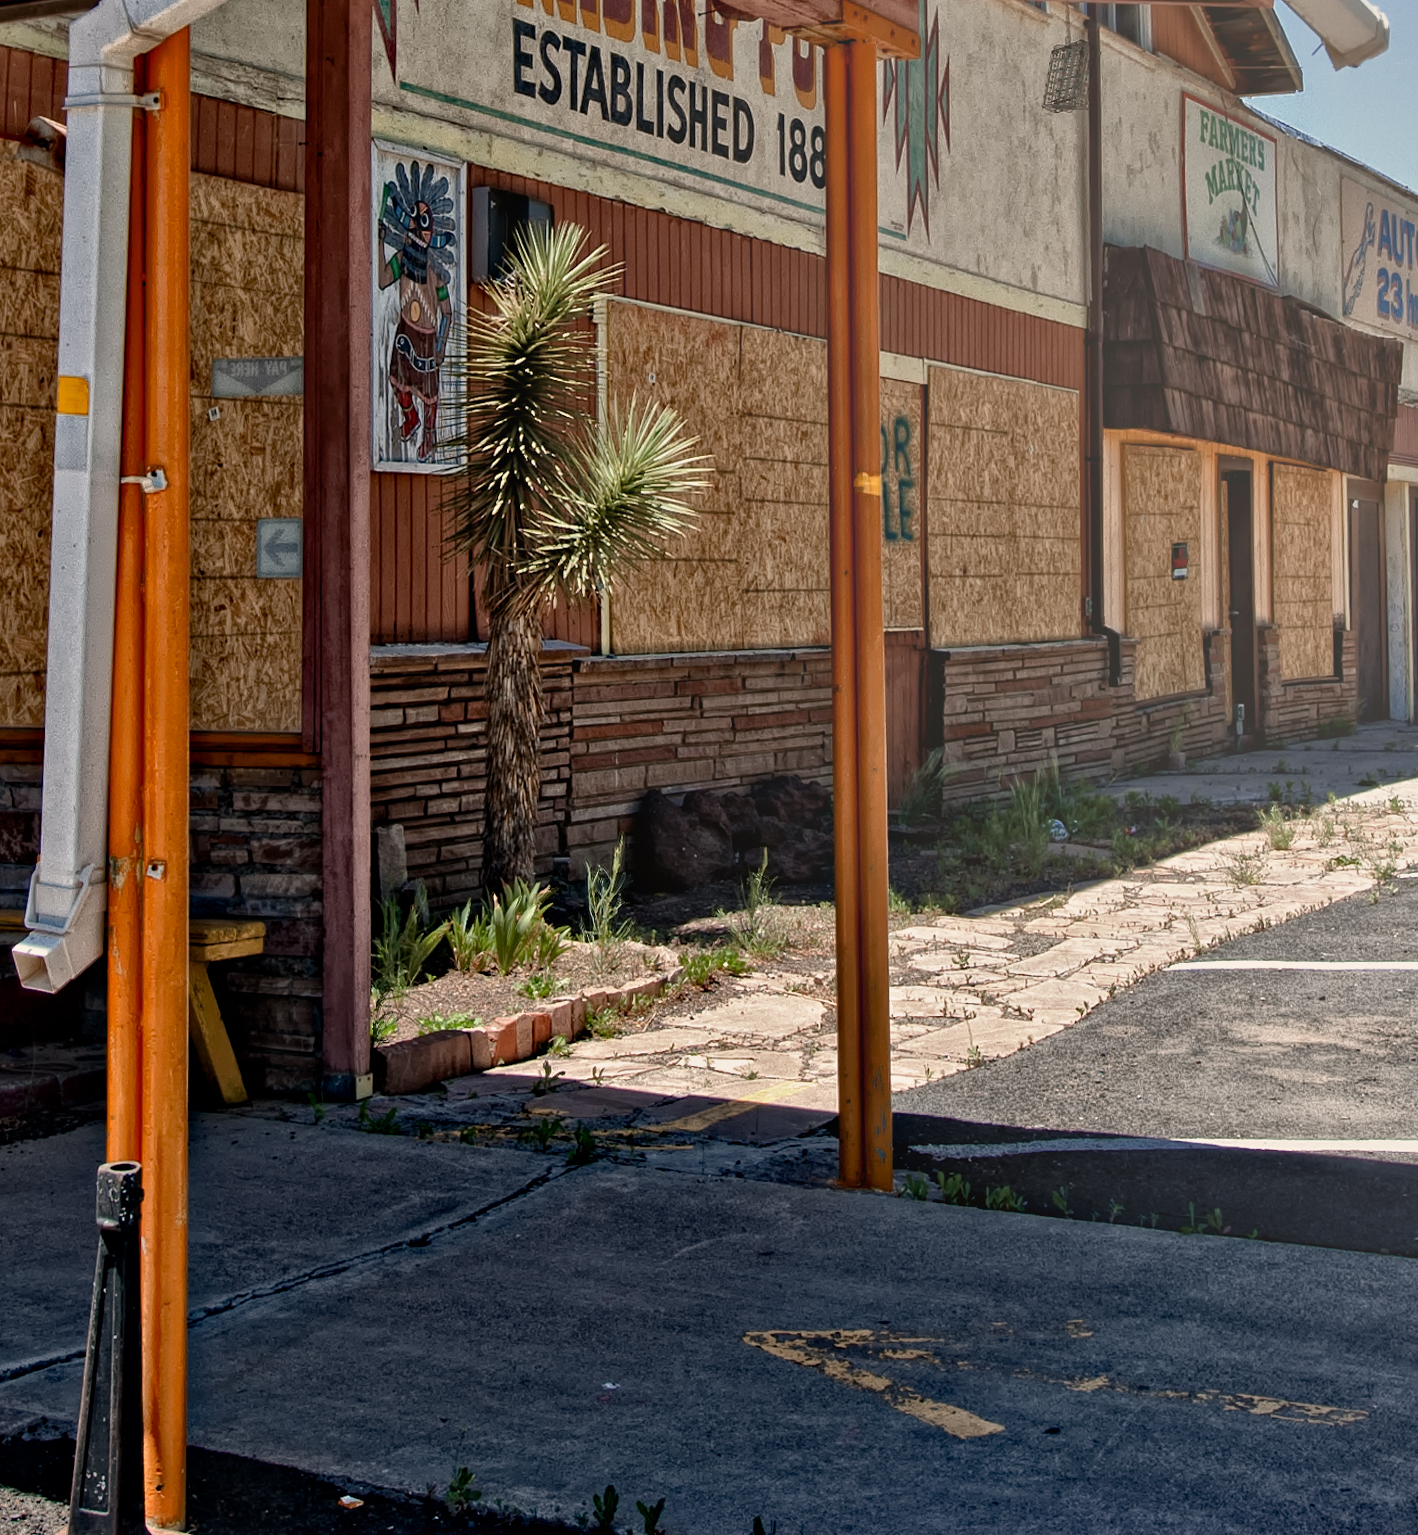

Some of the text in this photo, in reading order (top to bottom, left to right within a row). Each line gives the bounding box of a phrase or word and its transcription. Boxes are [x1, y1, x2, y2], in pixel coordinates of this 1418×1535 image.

[512, 17, 756, 165] ESTABLISHED
[1204, 157, 1261, 217] MARKET
[1376, 267, 1405, 325] 23
